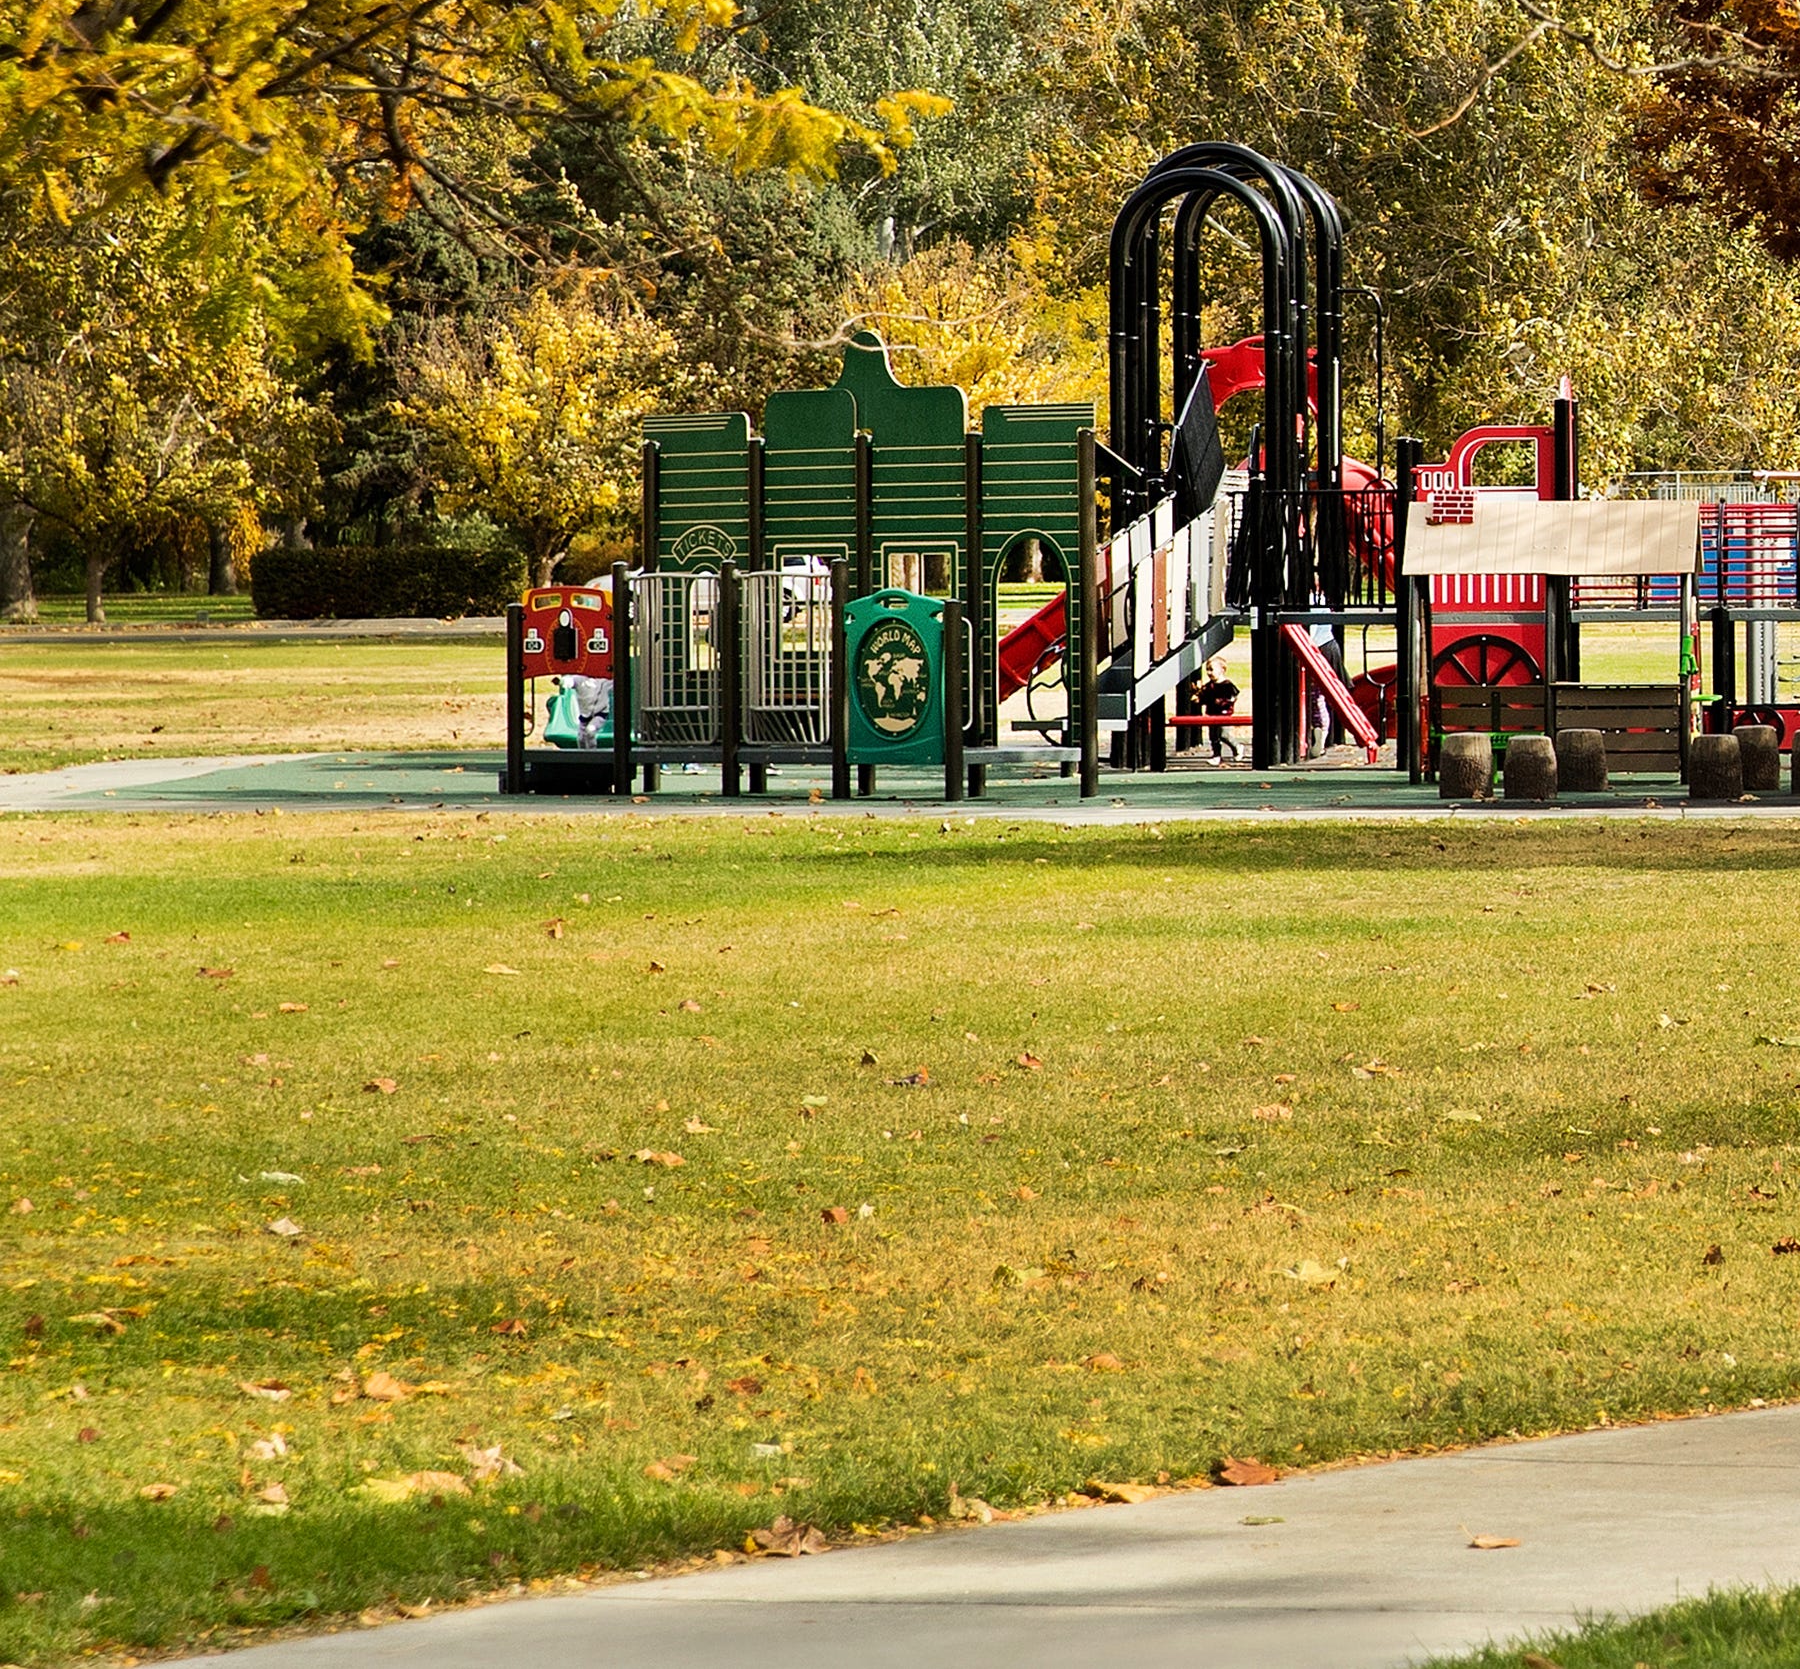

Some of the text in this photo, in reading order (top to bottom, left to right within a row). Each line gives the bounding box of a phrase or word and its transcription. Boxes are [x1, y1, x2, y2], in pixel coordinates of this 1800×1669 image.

[676, 530, 732, 557] TICKETS
[870, 630, 921, 653] WORLD MAP
